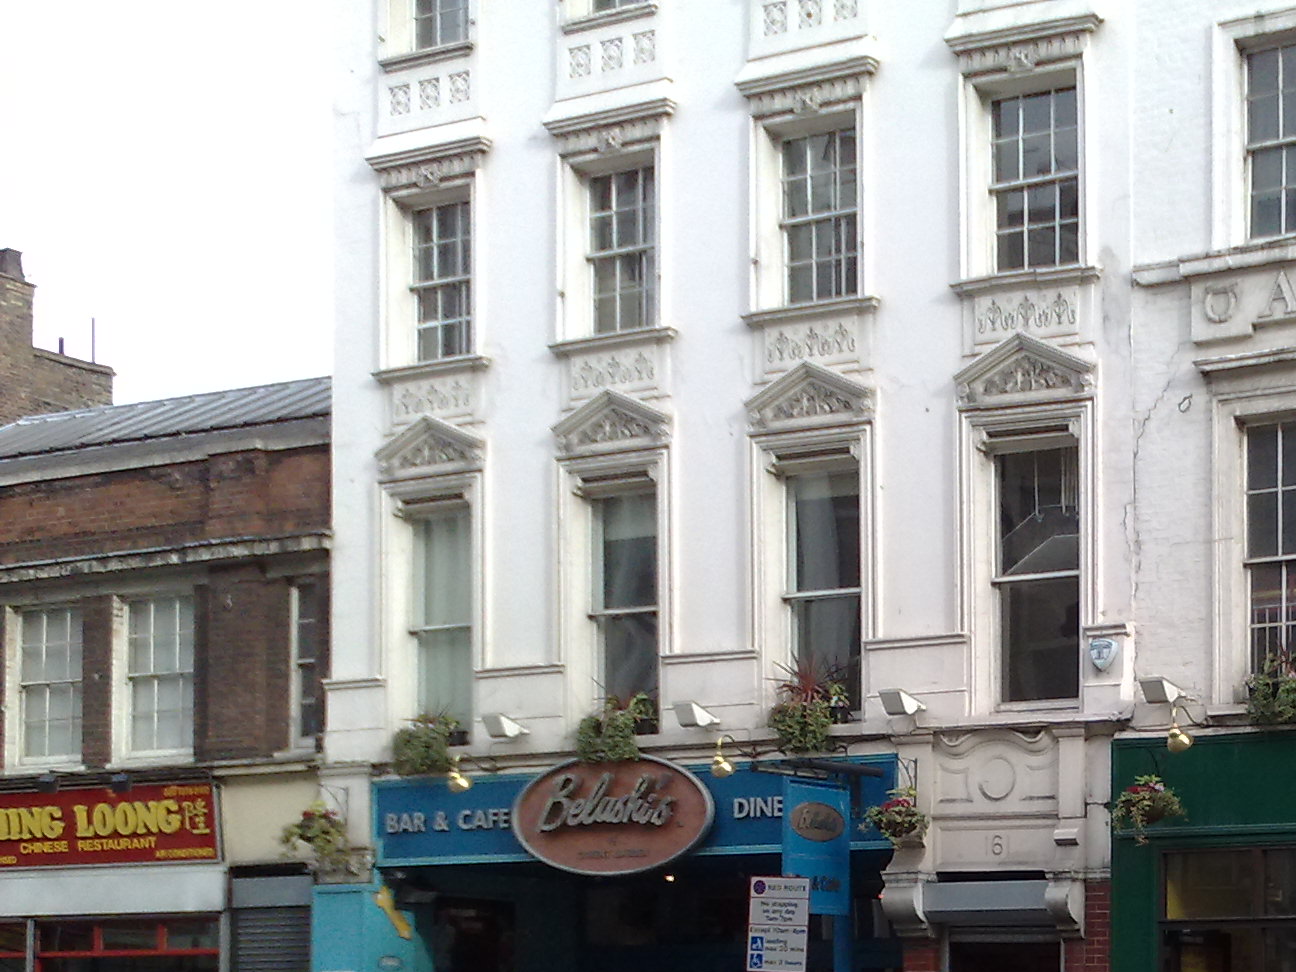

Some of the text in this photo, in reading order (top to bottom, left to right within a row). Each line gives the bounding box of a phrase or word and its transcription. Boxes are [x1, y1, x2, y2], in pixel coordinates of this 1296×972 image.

[73, 799, 182, 838] LOONG
[385, 808, 512, 834] BAR & CAFE
[19, 836, 157, 855] CHINESE RESTAURANT
